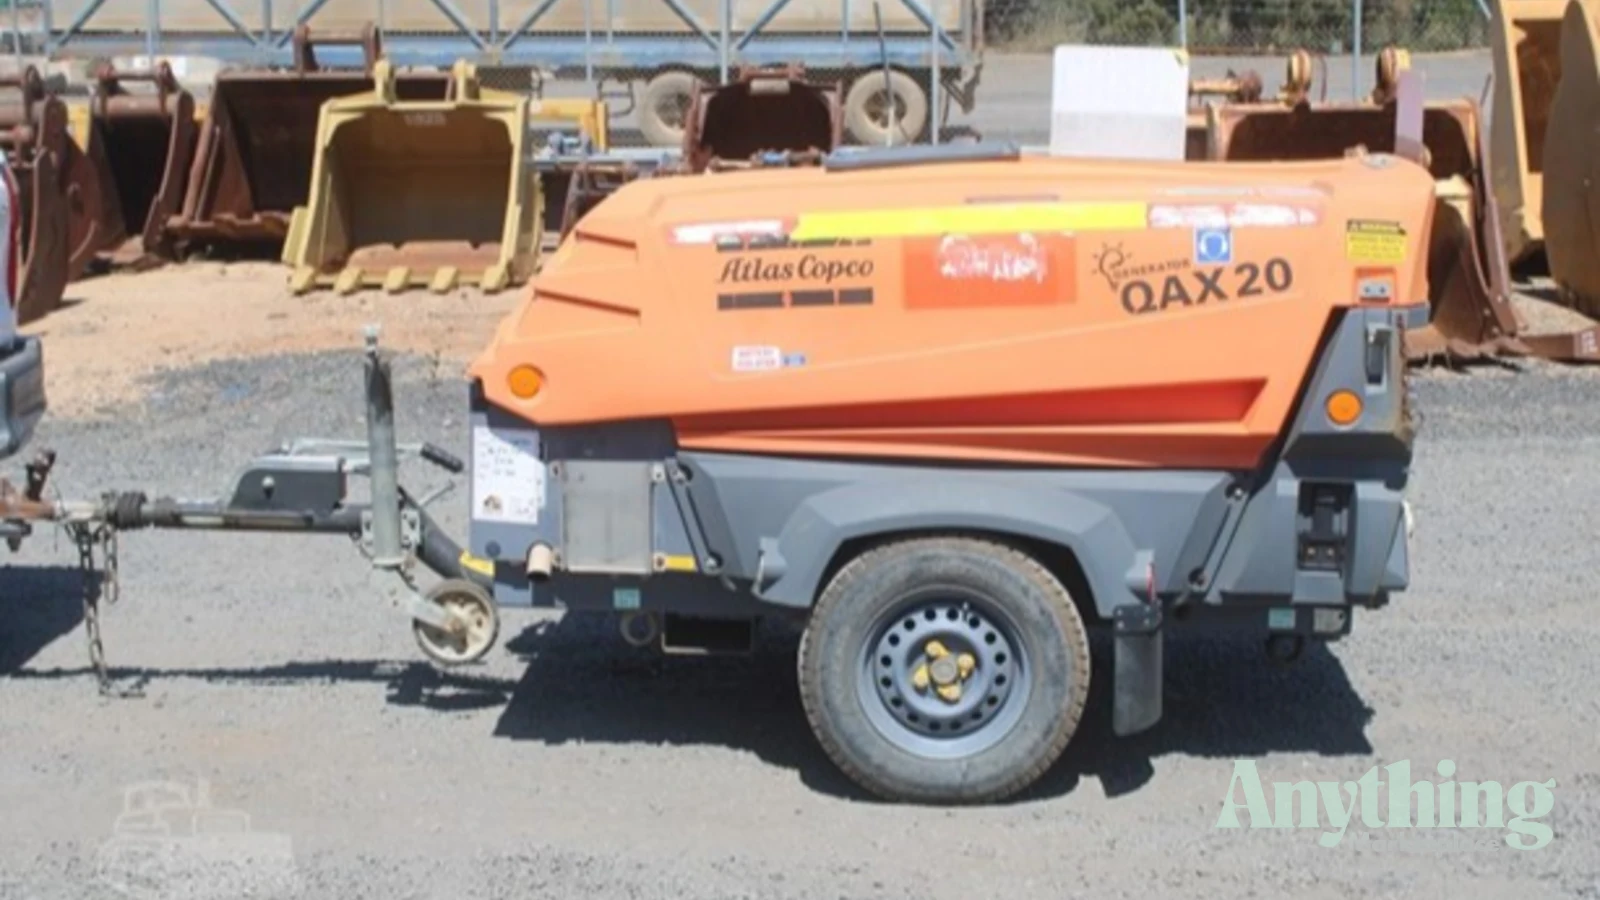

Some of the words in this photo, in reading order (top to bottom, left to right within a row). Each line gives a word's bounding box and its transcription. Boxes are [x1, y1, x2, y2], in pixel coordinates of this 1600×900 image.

[717, 256, 794, 284] Atlas
[798, 254, 874, 284] Copco
[1120, 266, 1229, 315] QAX
[1234, 257, 1294, 299] 20
